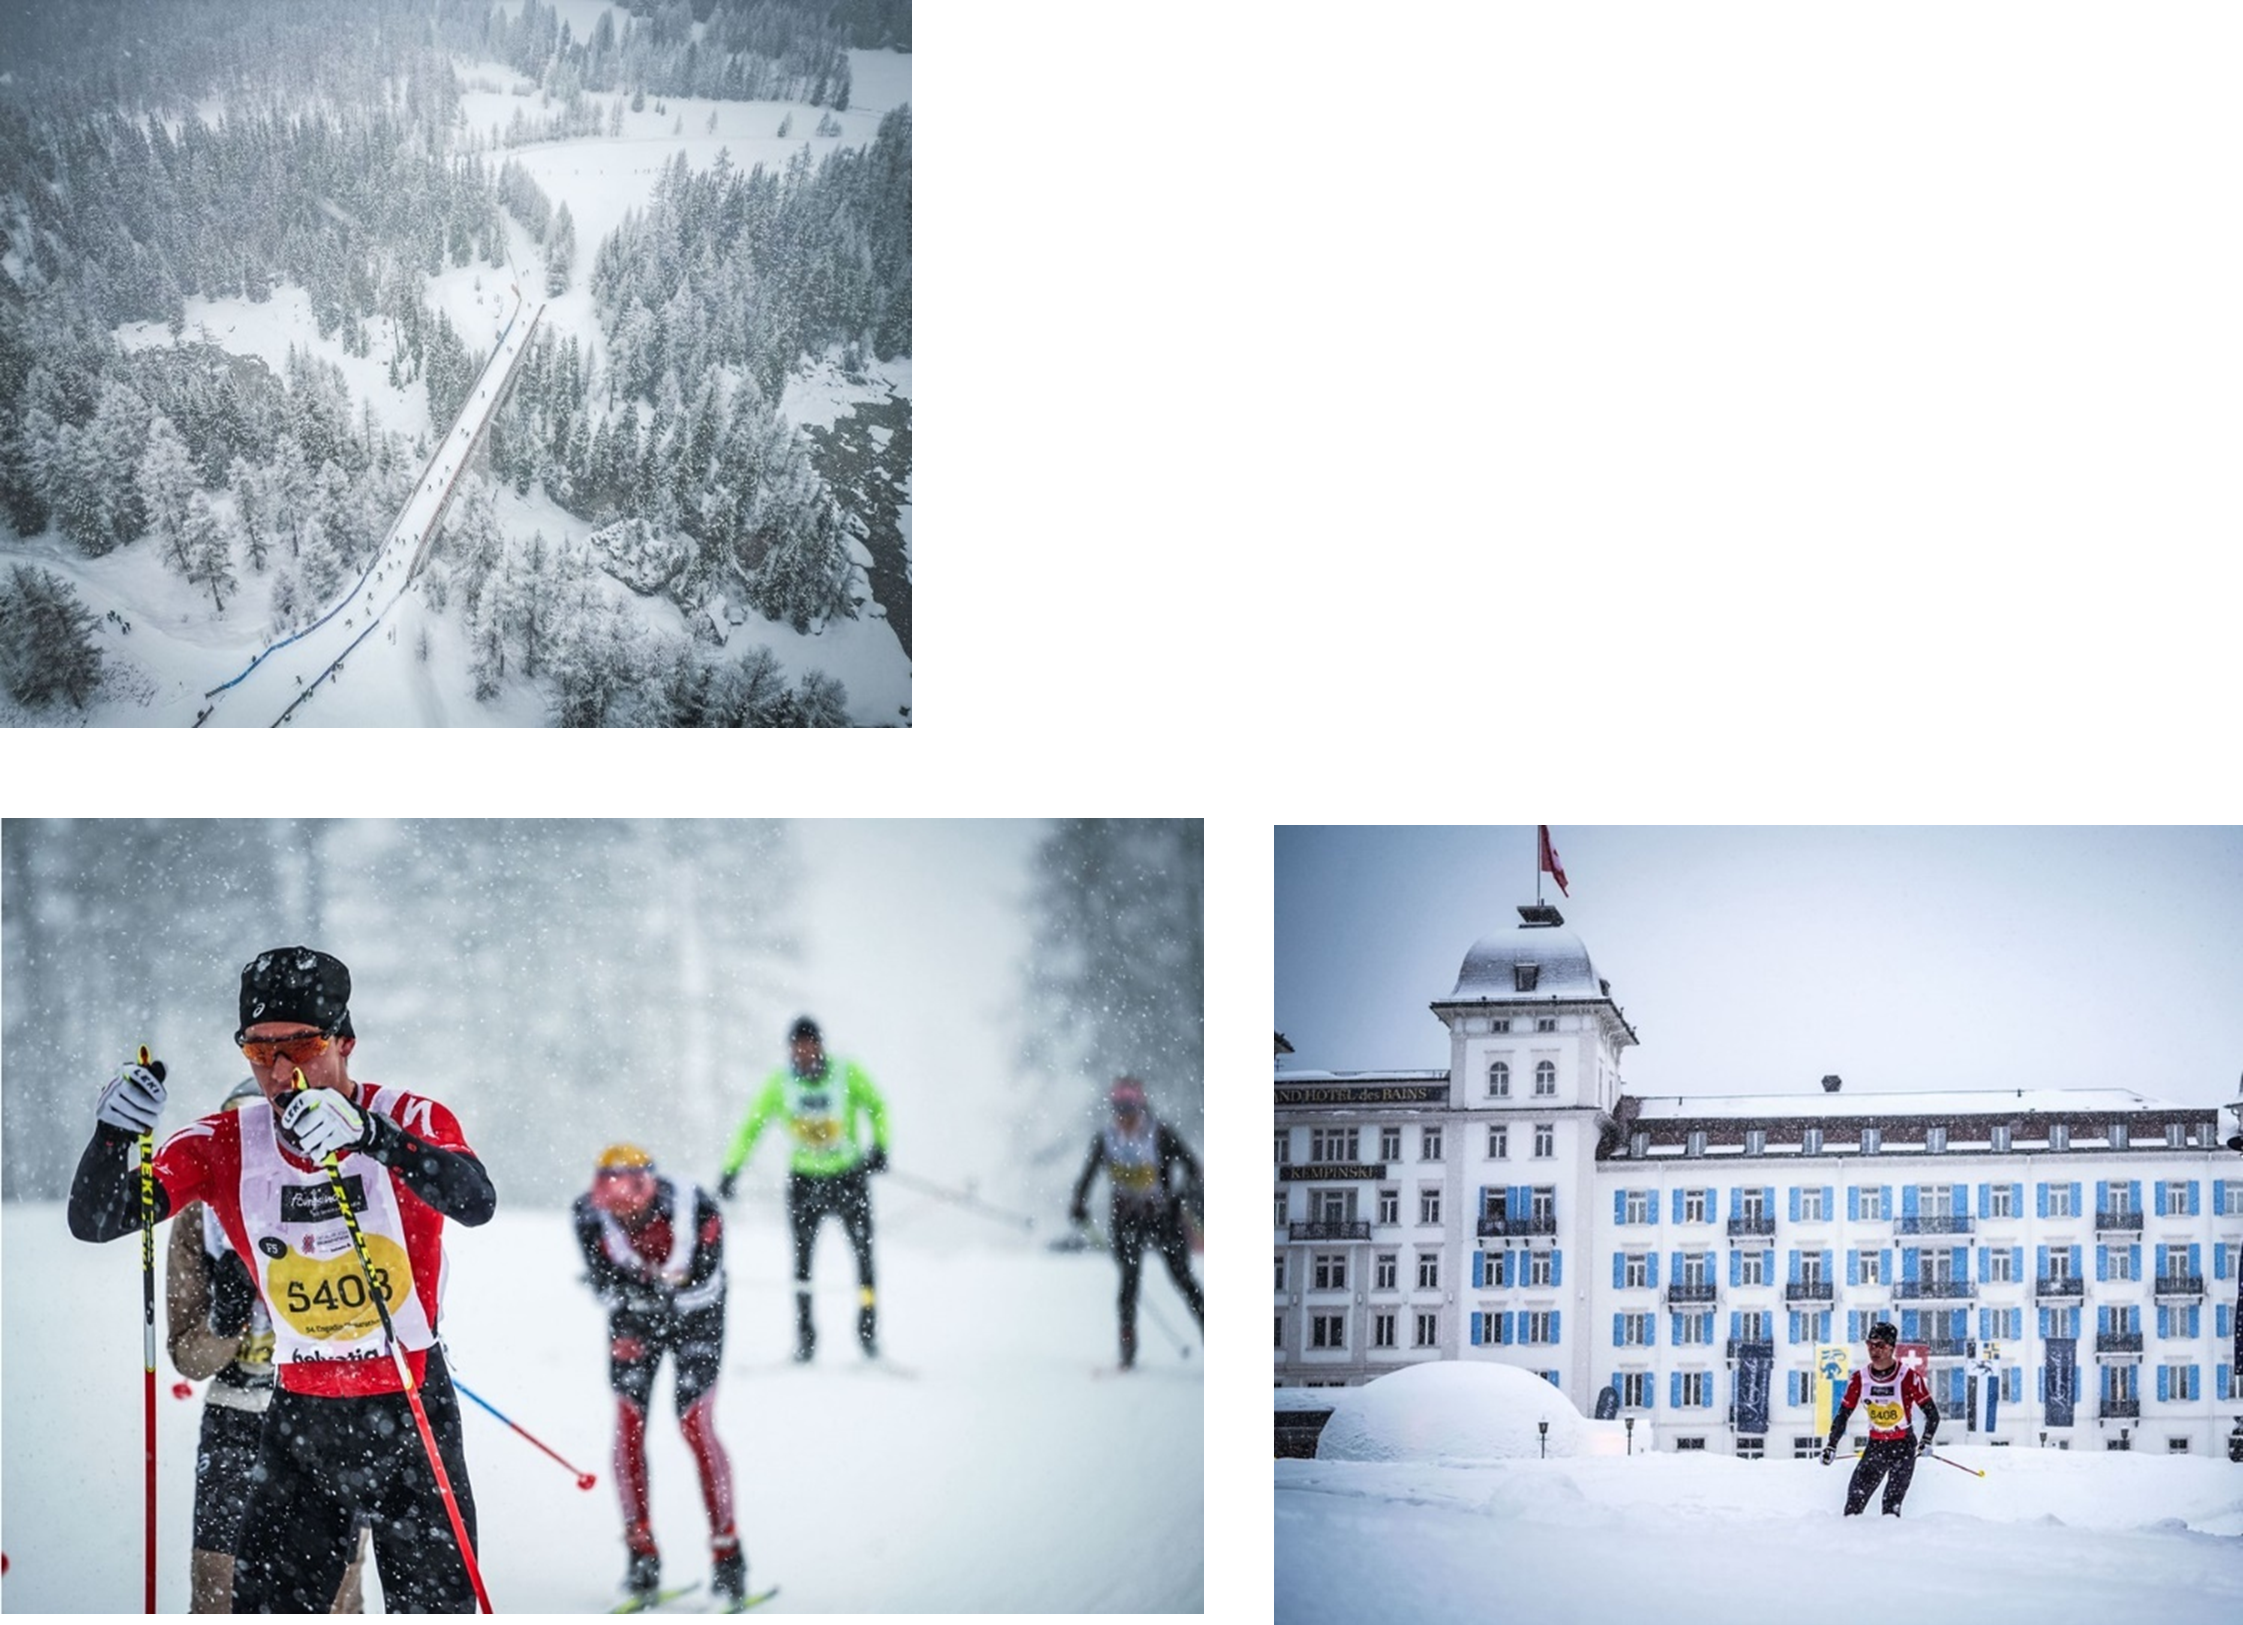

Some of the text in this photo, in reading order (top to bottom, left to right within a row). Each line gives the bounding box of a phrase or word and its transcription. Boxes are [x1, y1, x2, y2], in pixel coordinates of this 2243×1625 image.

[133, 1068, 160, 1095] LEKI
[1306, 1088, 1356, 1102] HOTEL
[1358, 1088, 1380, 1101] des
[1382, 1087, 1427, 1100] BAINS
[284, 1098, 304, 1124] LEKI
[140, 1143, 154, 1206] LEKI
[1290, 1165, 1375, 1179] KEMPINSKI
[292, 1347, 380, 1364] heltia
[1870, 1409, 1899, 1420] 5408
